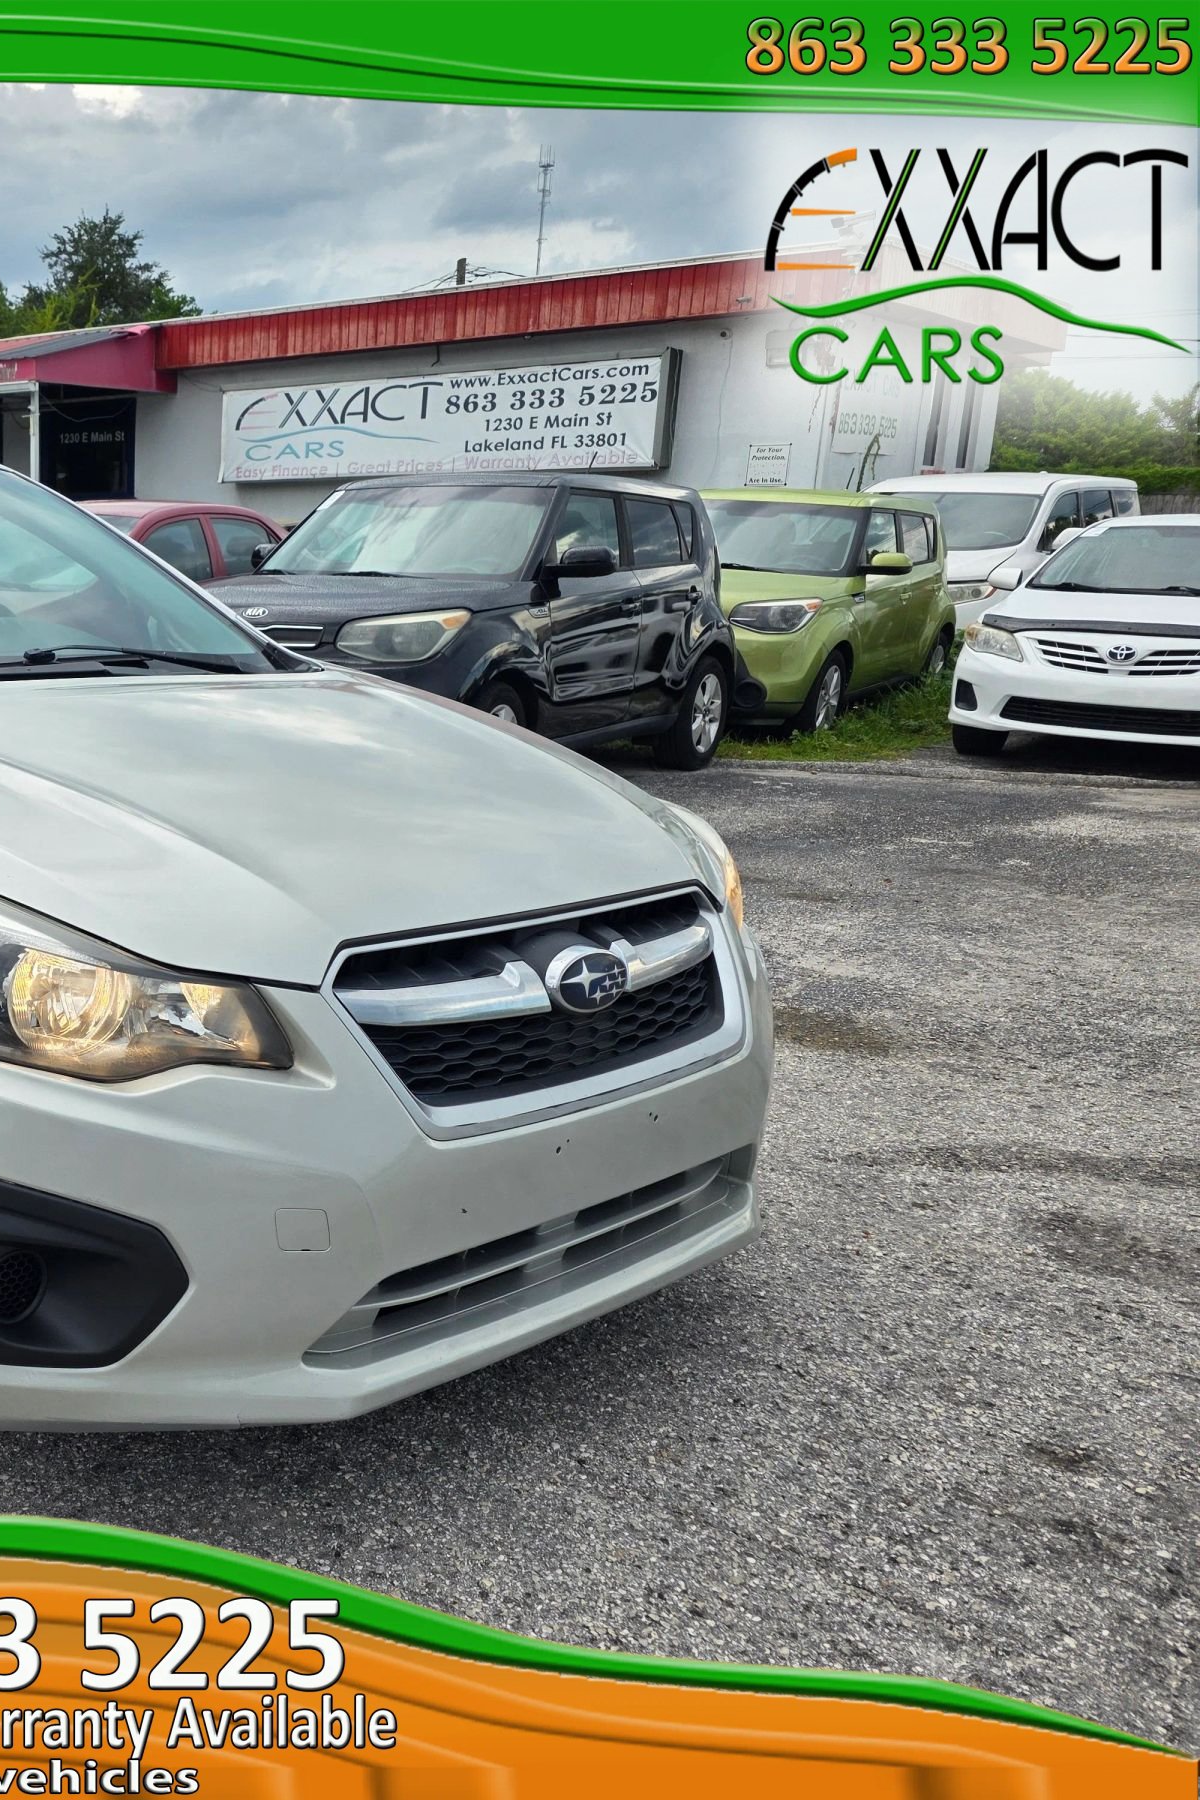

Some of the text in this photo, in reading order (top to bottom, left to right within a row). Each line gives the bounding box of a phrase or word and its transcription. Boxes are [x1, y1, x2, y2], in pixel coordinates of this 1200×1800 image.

[450, 363, 650, 389] www.ExxactCars.com
[235, 381, 443, 431] EXXACT
[445, 380, 658, 415] 863 333 5225
[485, 411, 613, 432] 1230 E Main St
[60, 430, 125, 444] 1230 E Main St
[464, 432, 627, 453] Lakeland FL 33801
[245, 440, 345, 462] CARS
[236, 466, 266, 480] Easy
[271, 463, 328, 479] Finance
[347, 460, 390, 475] Great
[398, 457, 444, 473] Prices
[464, 452, 542, 472] Warranty
[245, 608, 263, 616] KIA
